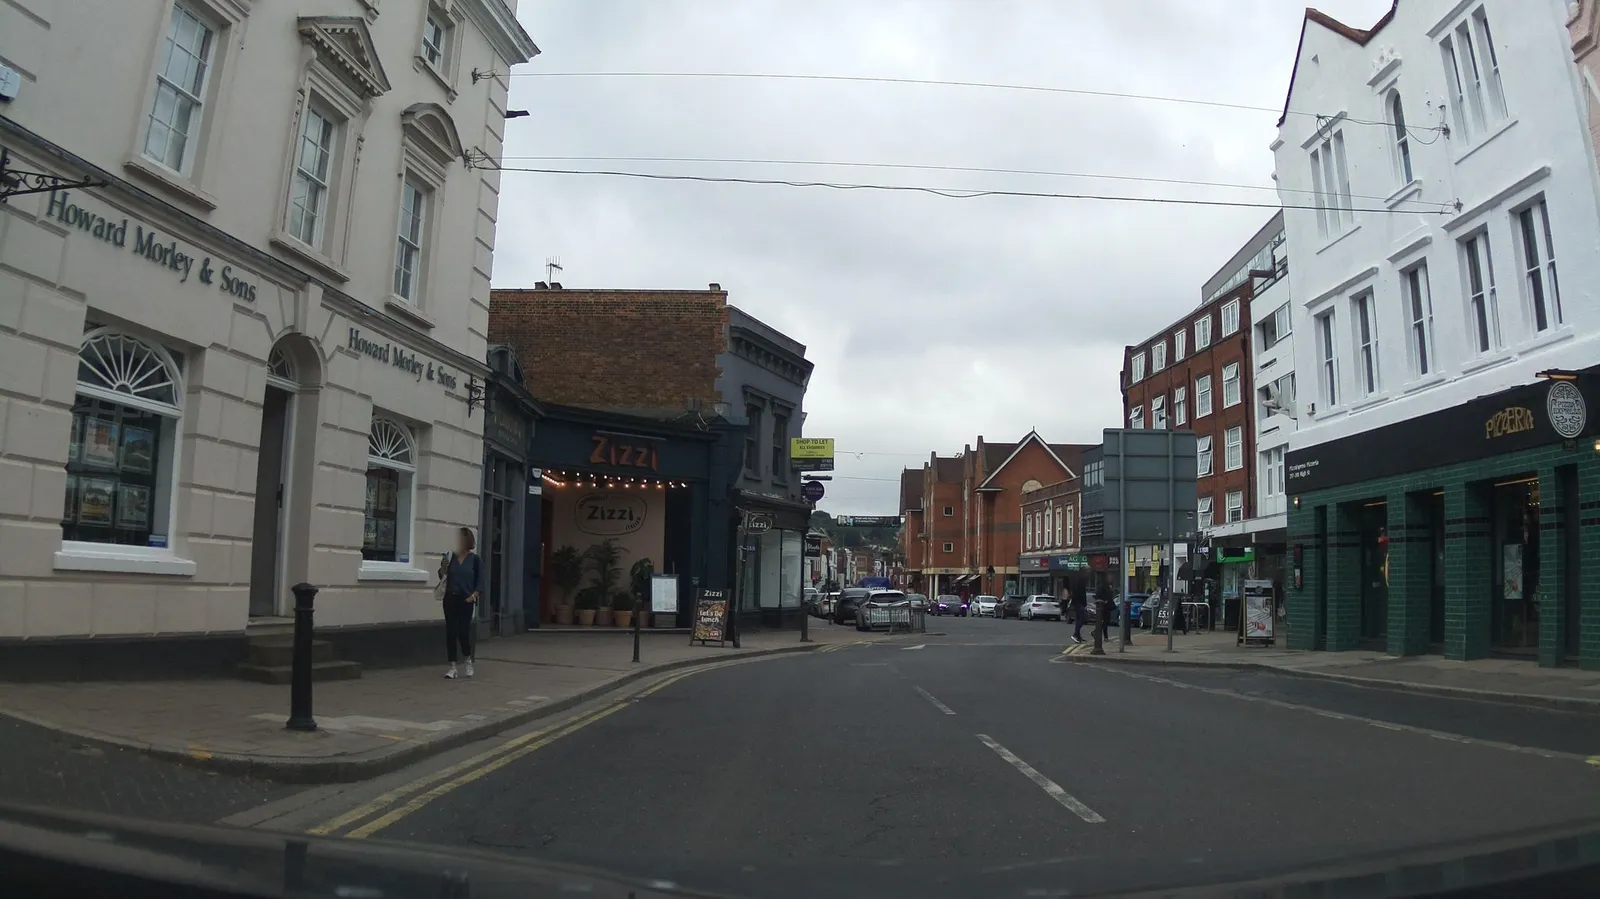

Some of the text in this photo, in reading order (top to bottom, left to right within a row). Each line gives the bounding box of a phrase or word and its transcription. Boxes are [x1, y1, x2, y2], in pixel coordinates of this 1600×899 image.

[46, 188, 256, 302] Howard Morley & Sons
[348, 327, 456, 389] Howard Morley & Sons
[1485, 406, 1535, 439] PIZZERIA
[590, 435, 658, 471] Zizzi
[587, 506, 633, 521] Zizzi
